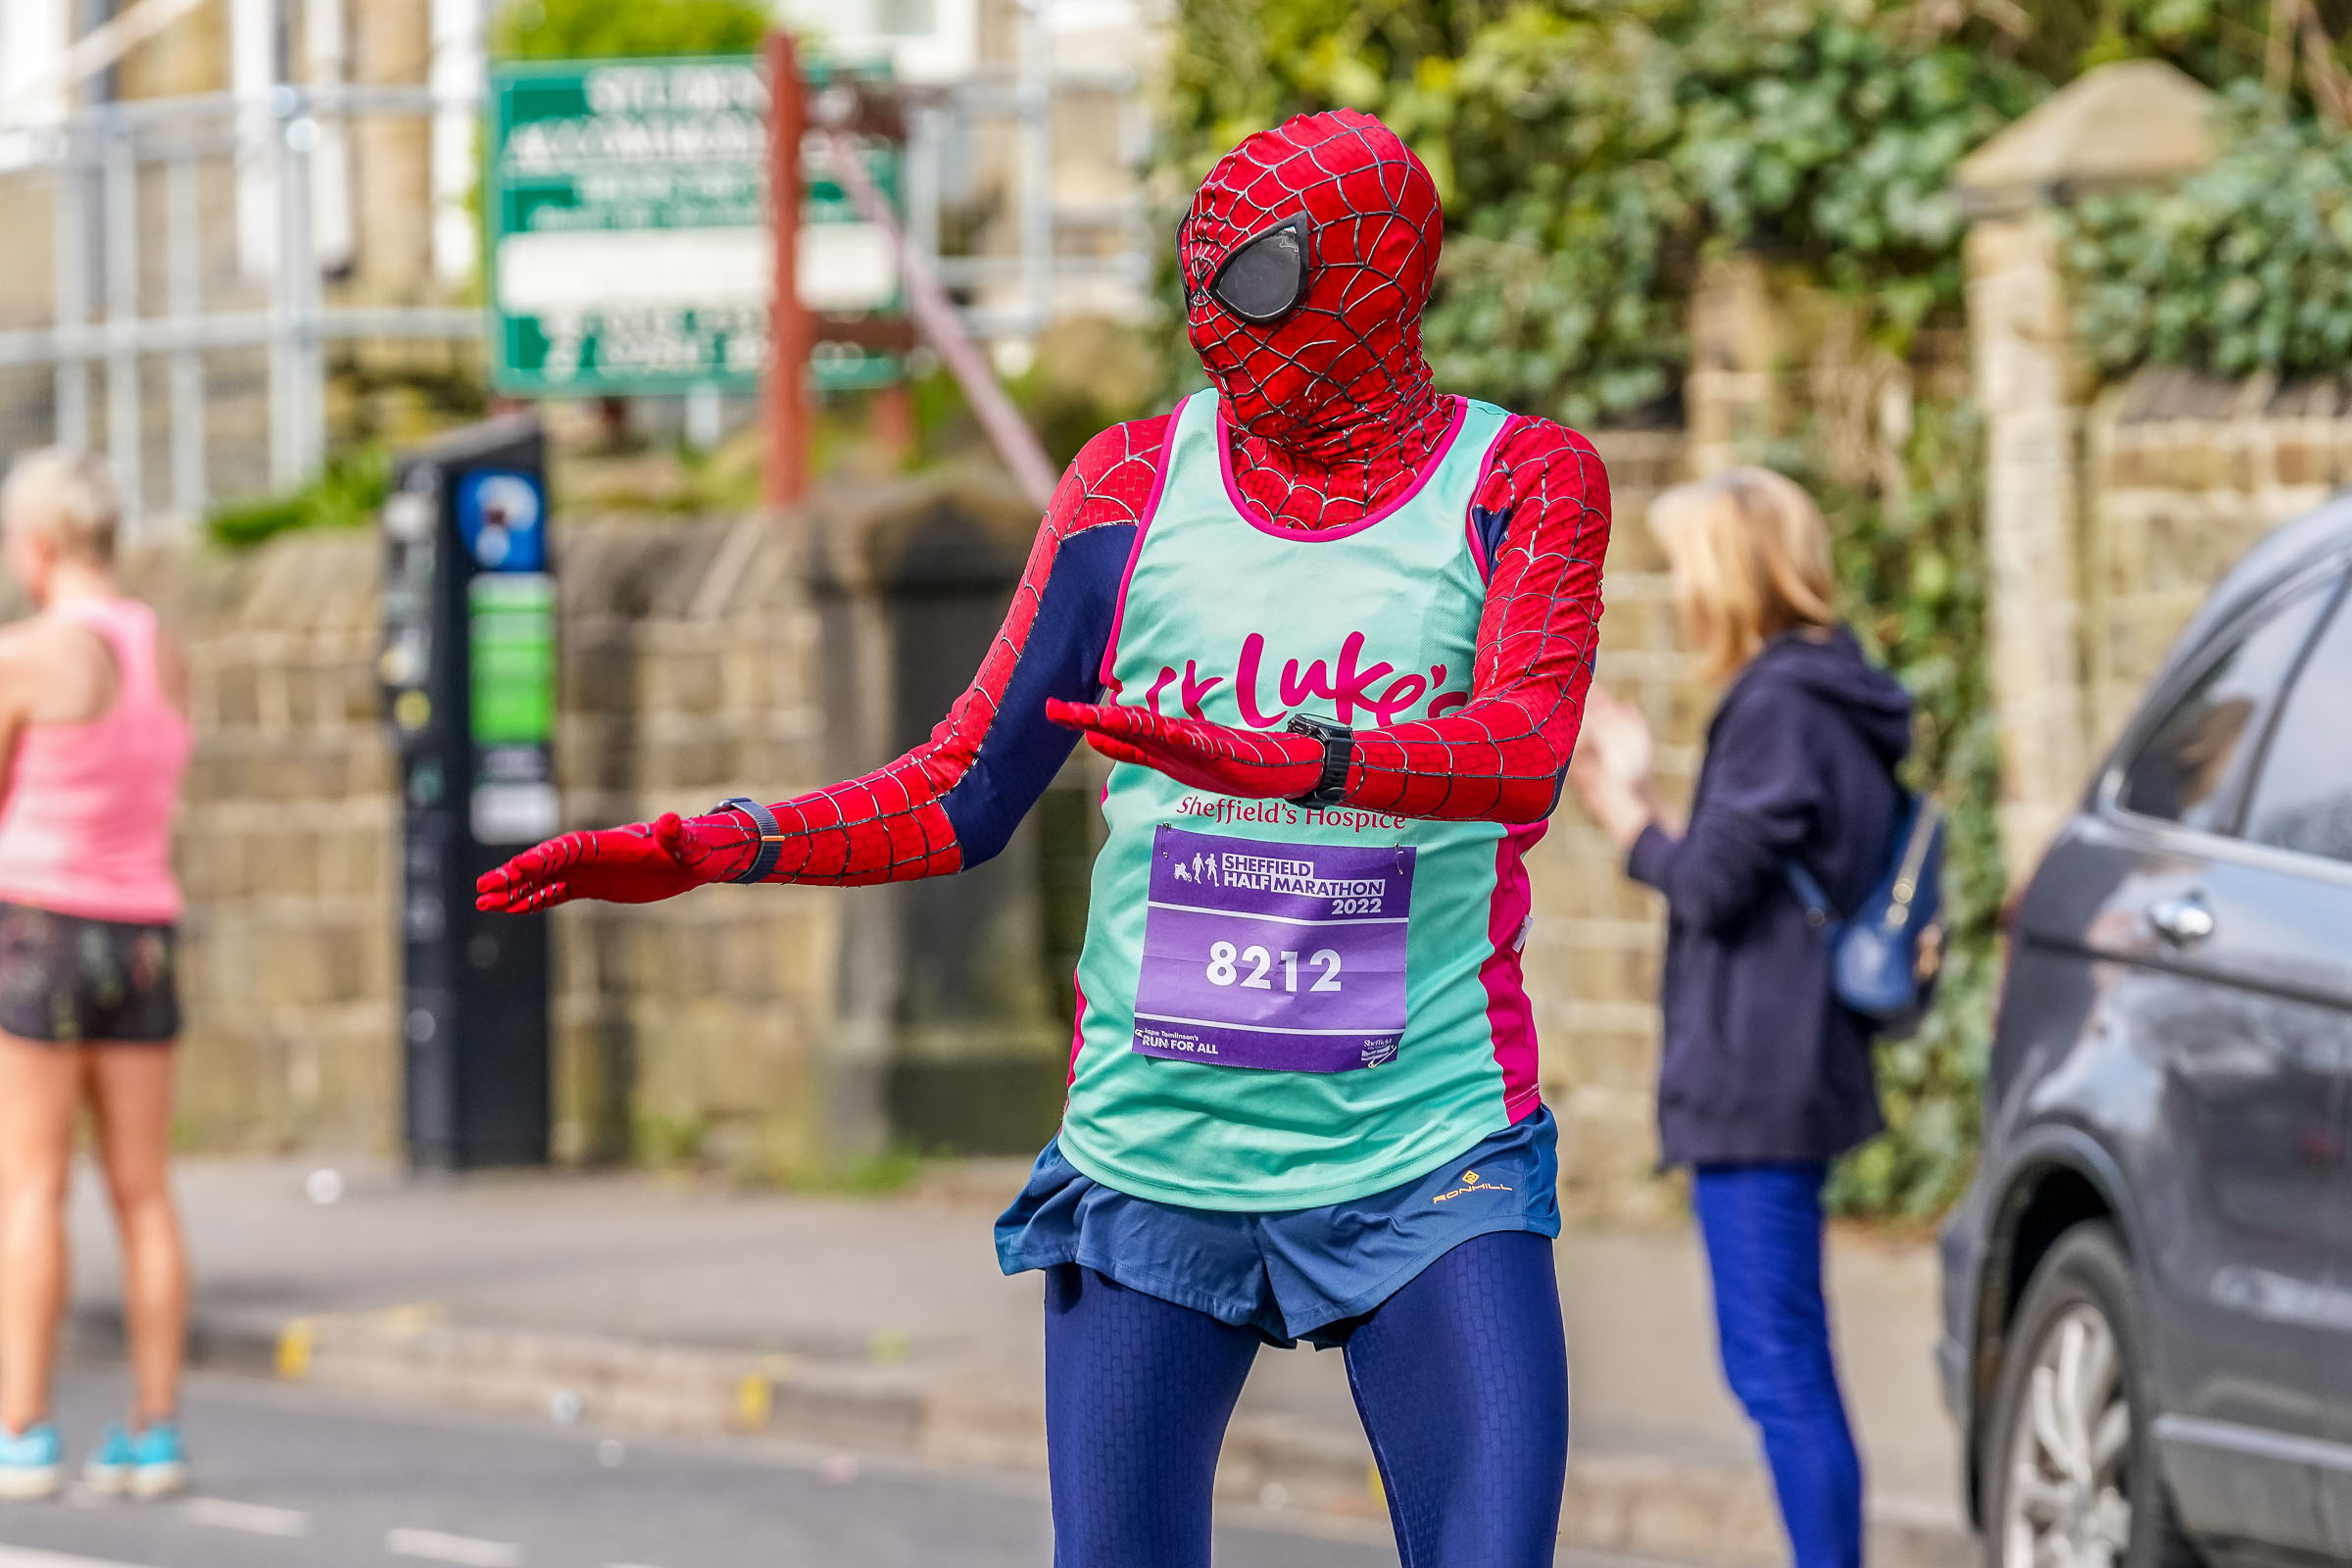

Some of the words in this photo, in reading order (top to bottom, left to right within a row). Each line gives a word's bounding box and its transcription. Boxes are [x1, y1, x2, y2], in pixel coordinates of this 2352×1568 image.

[1176, 796, 1297, 824] Sheffield's
[1306, 808, 1405, 832] Hospice
[1224, 855, 1311, 877] SHEFFIELD
[1224, 871, 1270, 891] HALF
[1273, 876, 1383, 896] MARATHON
[1331, 898, 1382, 915] 2022
[1205, 941, 1342, 992] 8212
[1142, 1035, 1168, 1049] RUN
[1170, 1039, 1195, 1052] FOR
[1197, 1043, 1219, 1054] ALL
[1161, 1030, 1199, 1041] Tomlinson's
[1433, 1183, 1512, 1203] RONHILL
